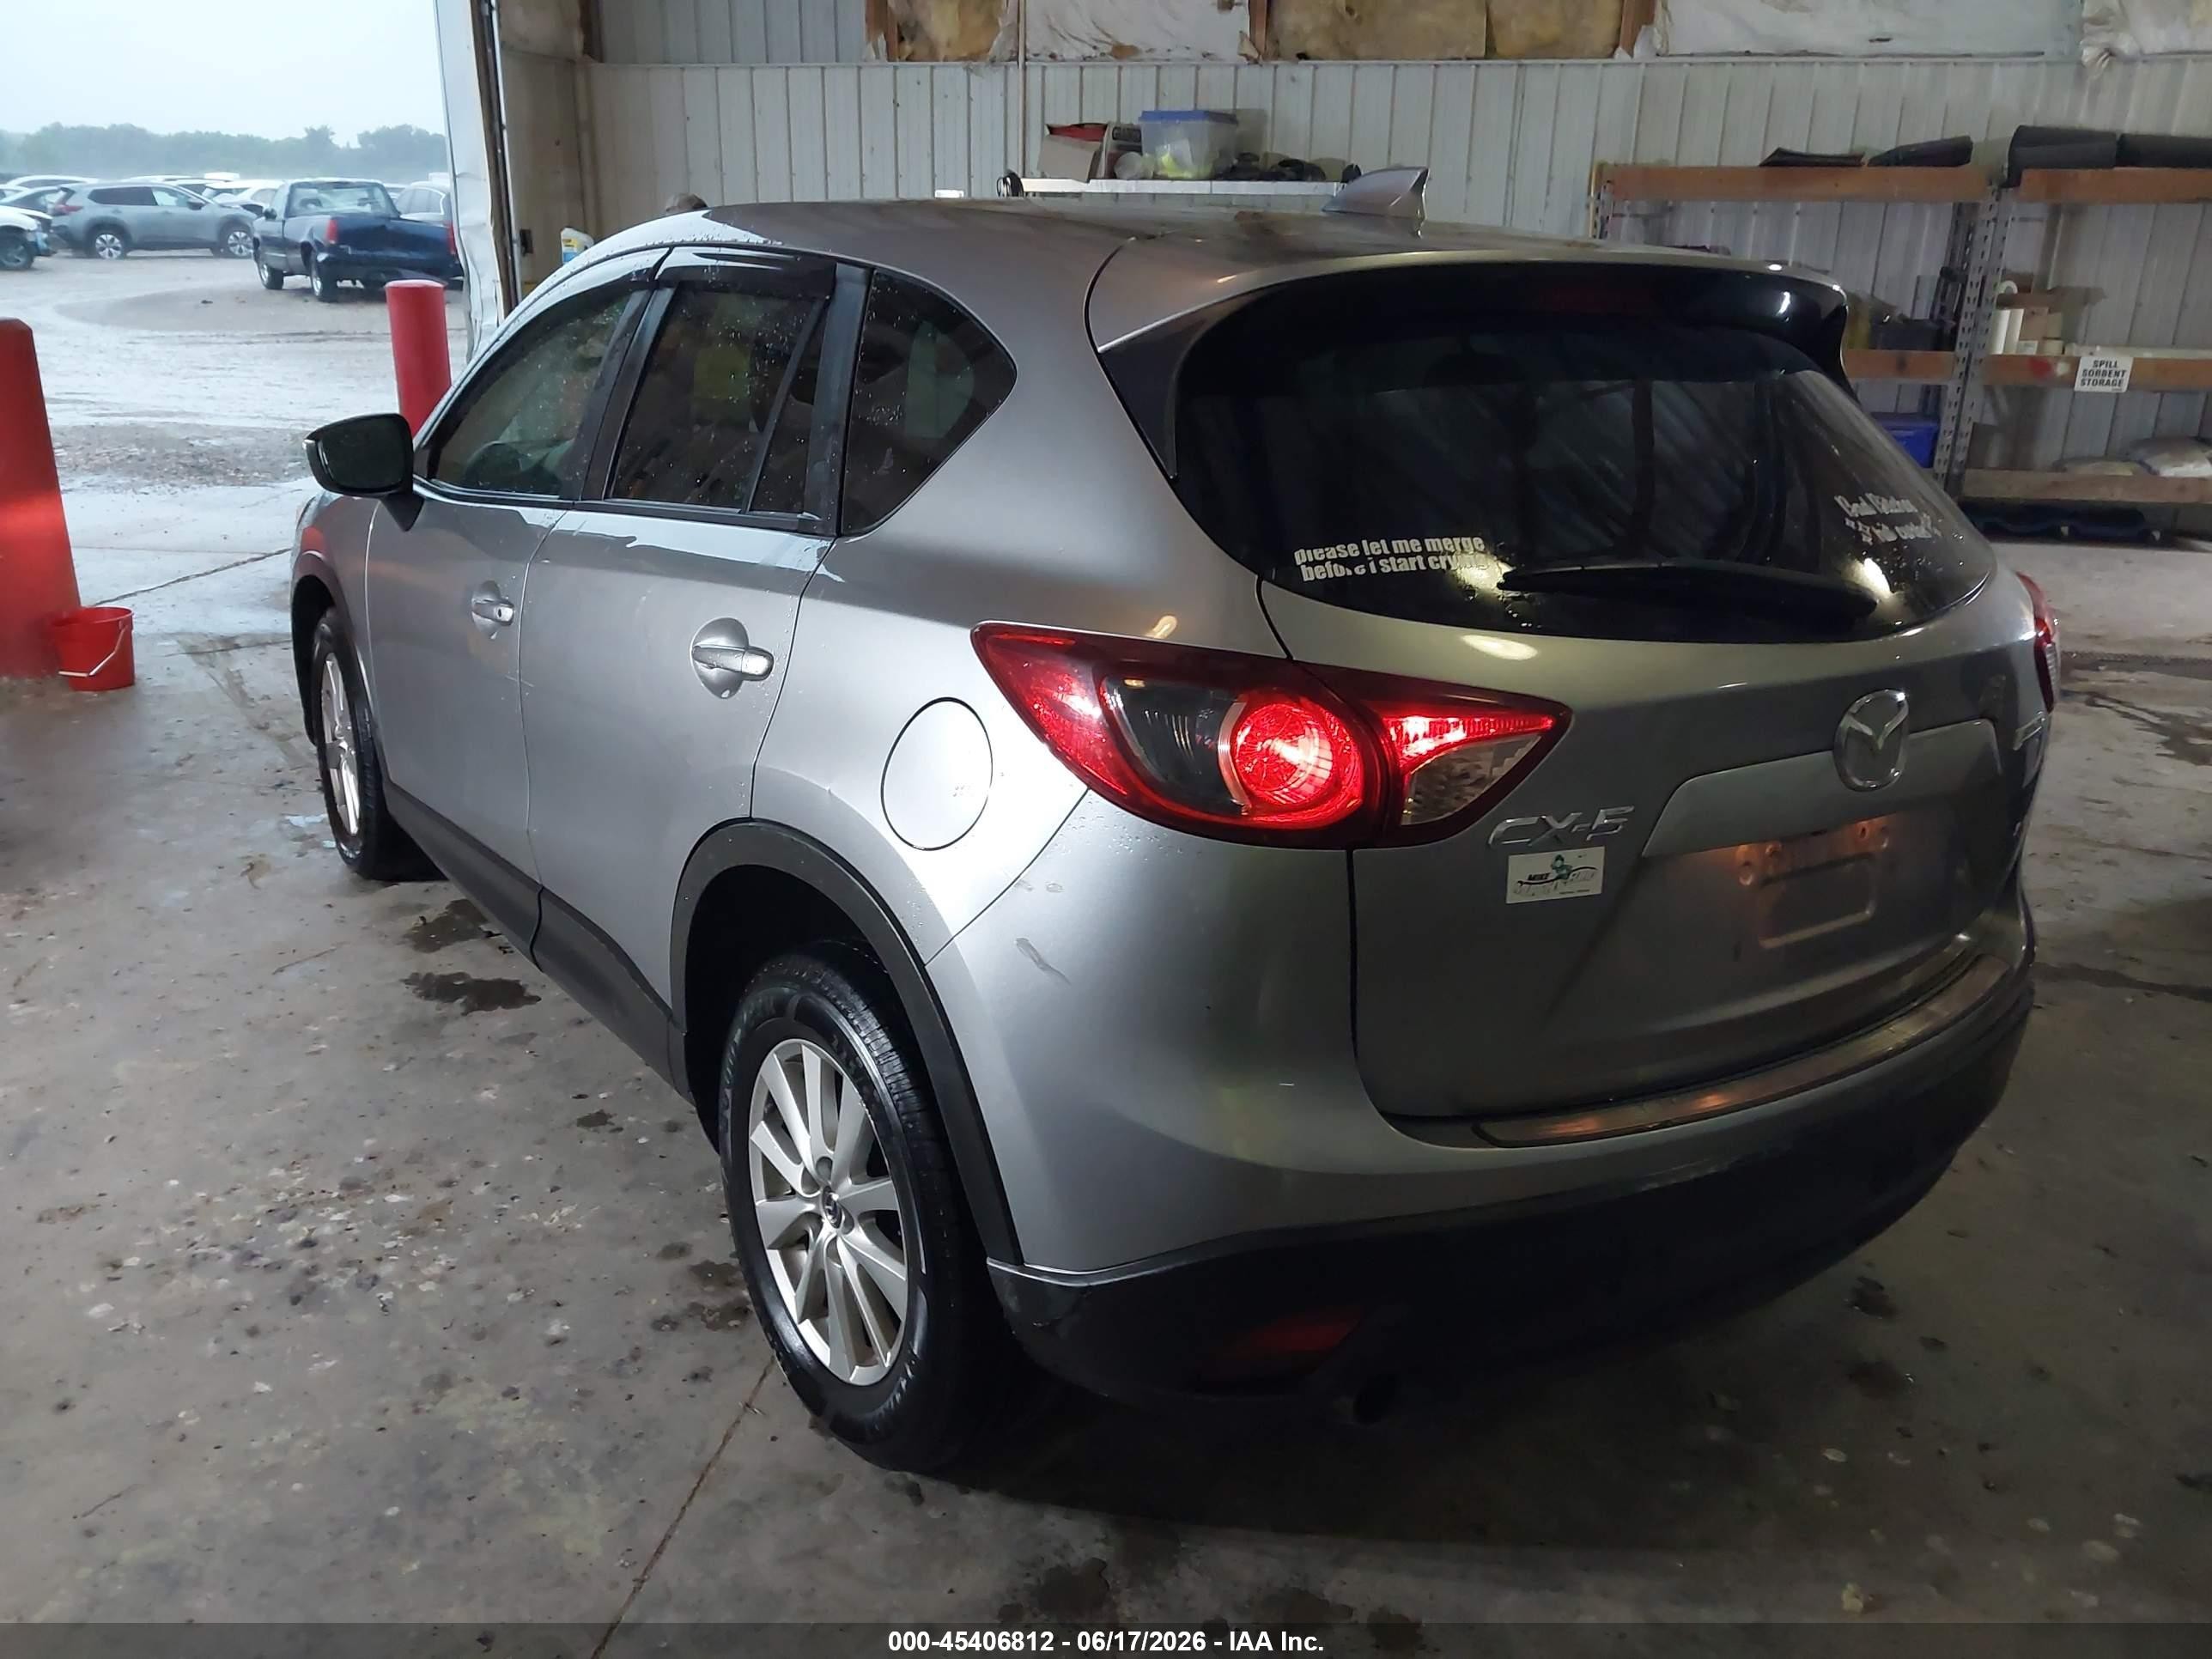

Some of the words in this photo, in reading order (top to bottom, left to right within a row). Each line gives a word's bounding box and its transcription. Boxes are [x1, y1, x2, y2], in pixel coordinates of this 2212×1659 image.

[2081, 369, 2127, 378] SORBENT
[2093, 360, 2118, 368] SPILL
[1294, 543, 1360, 566] please
[1361, 539, 1390, 556] let
[1391, 538, 1422, 554] me
[1424, 537, 1485, 555] merge
[1378, 555, 1426, 574] start
[1487, 805, 1635, 848] CX-5
